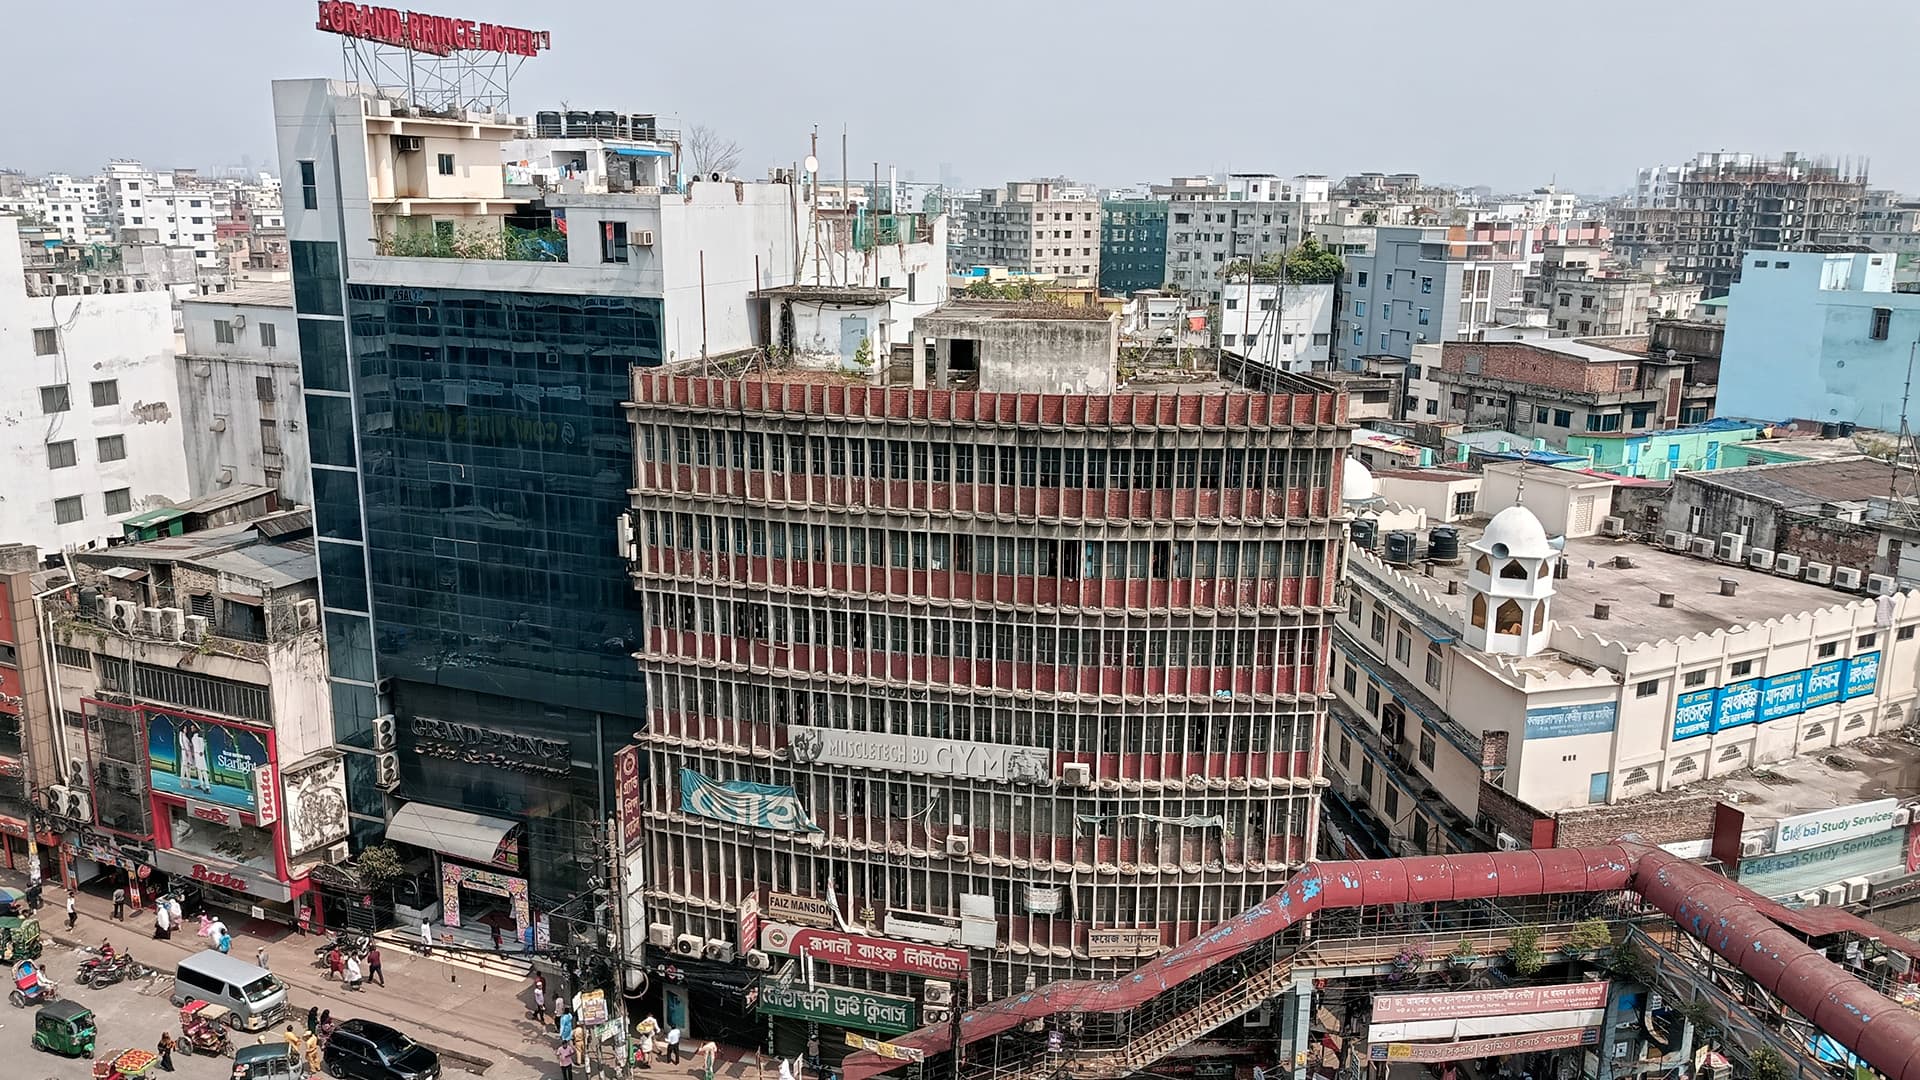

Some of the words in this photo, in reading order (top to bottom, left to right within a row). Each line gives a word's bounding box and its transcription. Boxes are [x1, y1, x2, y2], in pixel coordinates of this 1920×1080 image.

[327, 1, 402, 38] GRAND
[408, 10, 476, 50] PRINCE
[481, 23, 537, 56] HOTEL
[411, 716, 483, 747] GRAND
[488, 729, 570, 761] PRINCE
[829, 739, 907, 764] MUSCLETECH
[912, 749, 929, 765] BD
[936, 745, 1006, 778] GYM
[261, 769, 276, 821] Bata
[1821, 819, 1851, 832] Study
[1852, 811, 1894, 827] Services
[1842, 833, 1894, 855] Services
[191, 864, 248, 890] Bata
[770, 896, 789, 909] FAIZ
[791, 900, 832, 915] MANSION
[1090, 935, 1120, 944] ফয়েজ
[1122, 934, 1159, 944] ম্যানসন
[808, 935, 852, 956] রূপালী
[857, 943, 897, 962] ব্যাংক
[902, 947, 962, 971] লিমিটেড
[834, 996, 861, 1016] ড্রাই
